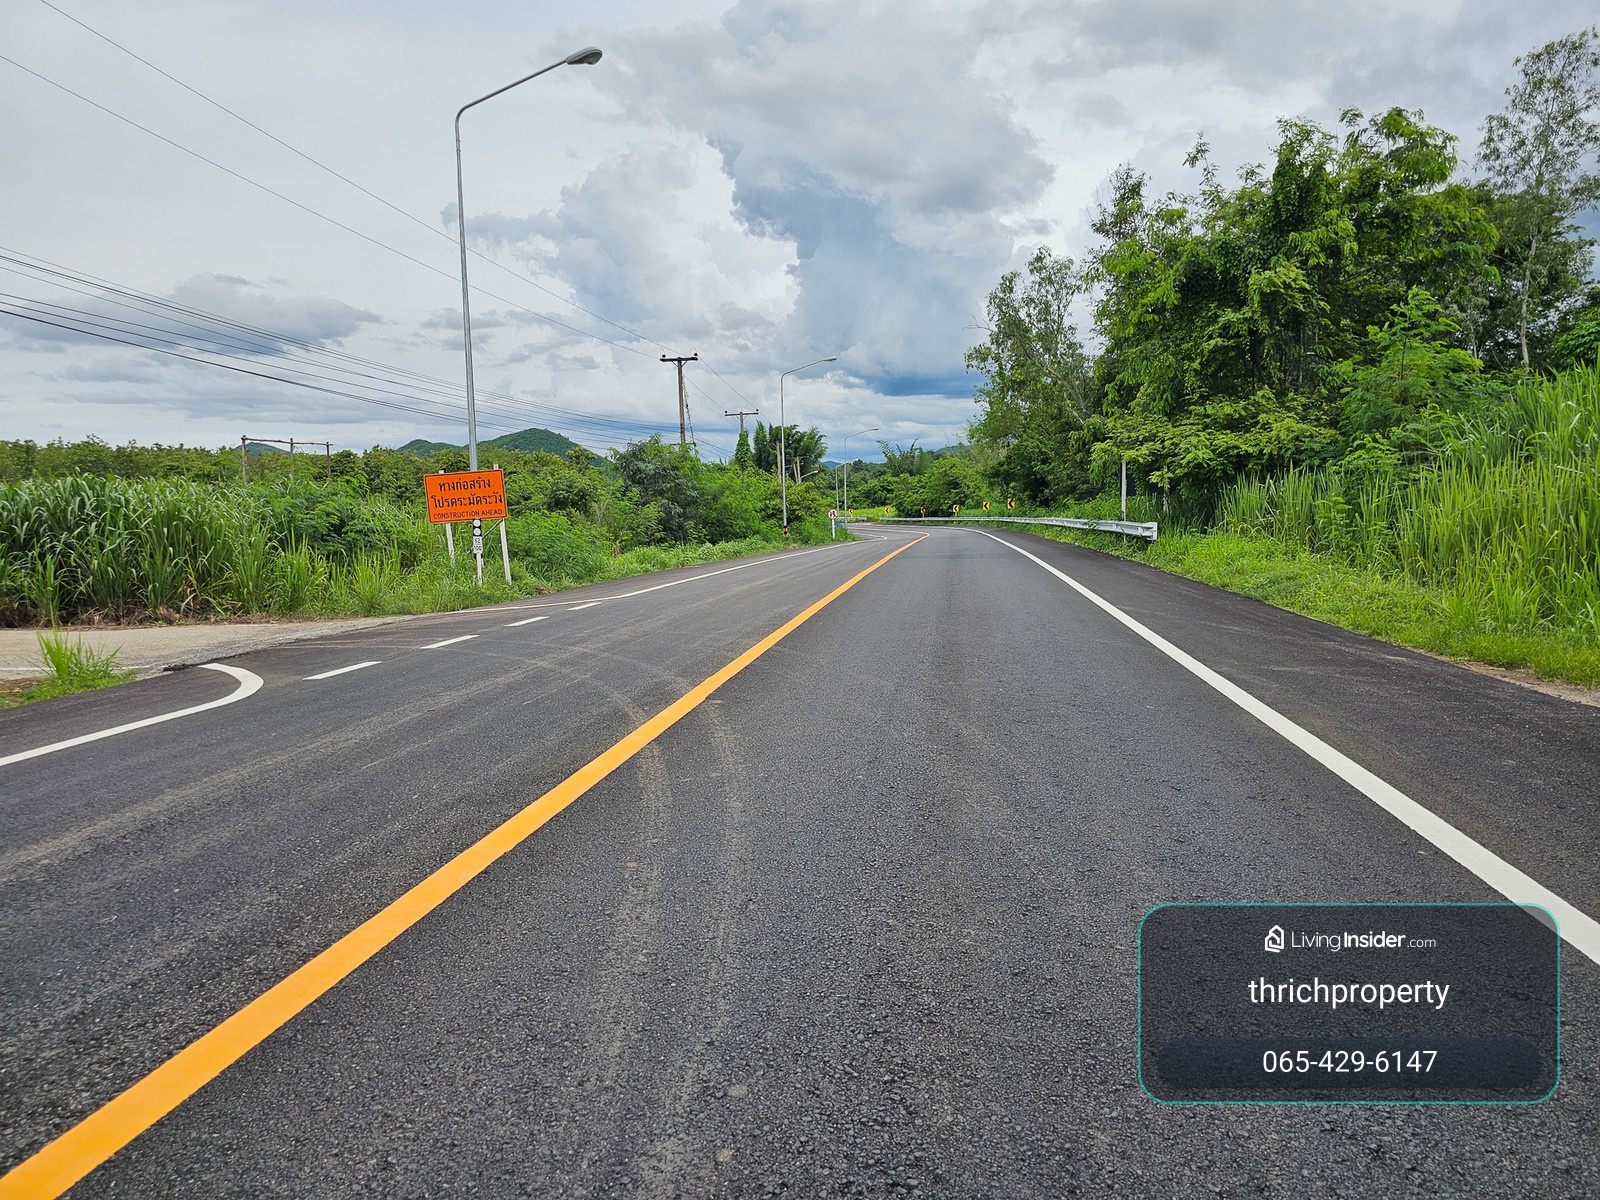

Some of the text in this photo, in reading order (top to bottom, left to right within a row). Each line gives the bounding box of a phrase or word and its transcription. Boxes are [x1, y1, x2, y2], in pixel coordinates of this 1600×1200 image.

[438, 476, 491, 492] ทางก่อสร้าง
[430, 491, 503, 508] โปรดระมัดระวัง
[433, 508, 503, 520] CONSTRUCTION AHEAD
